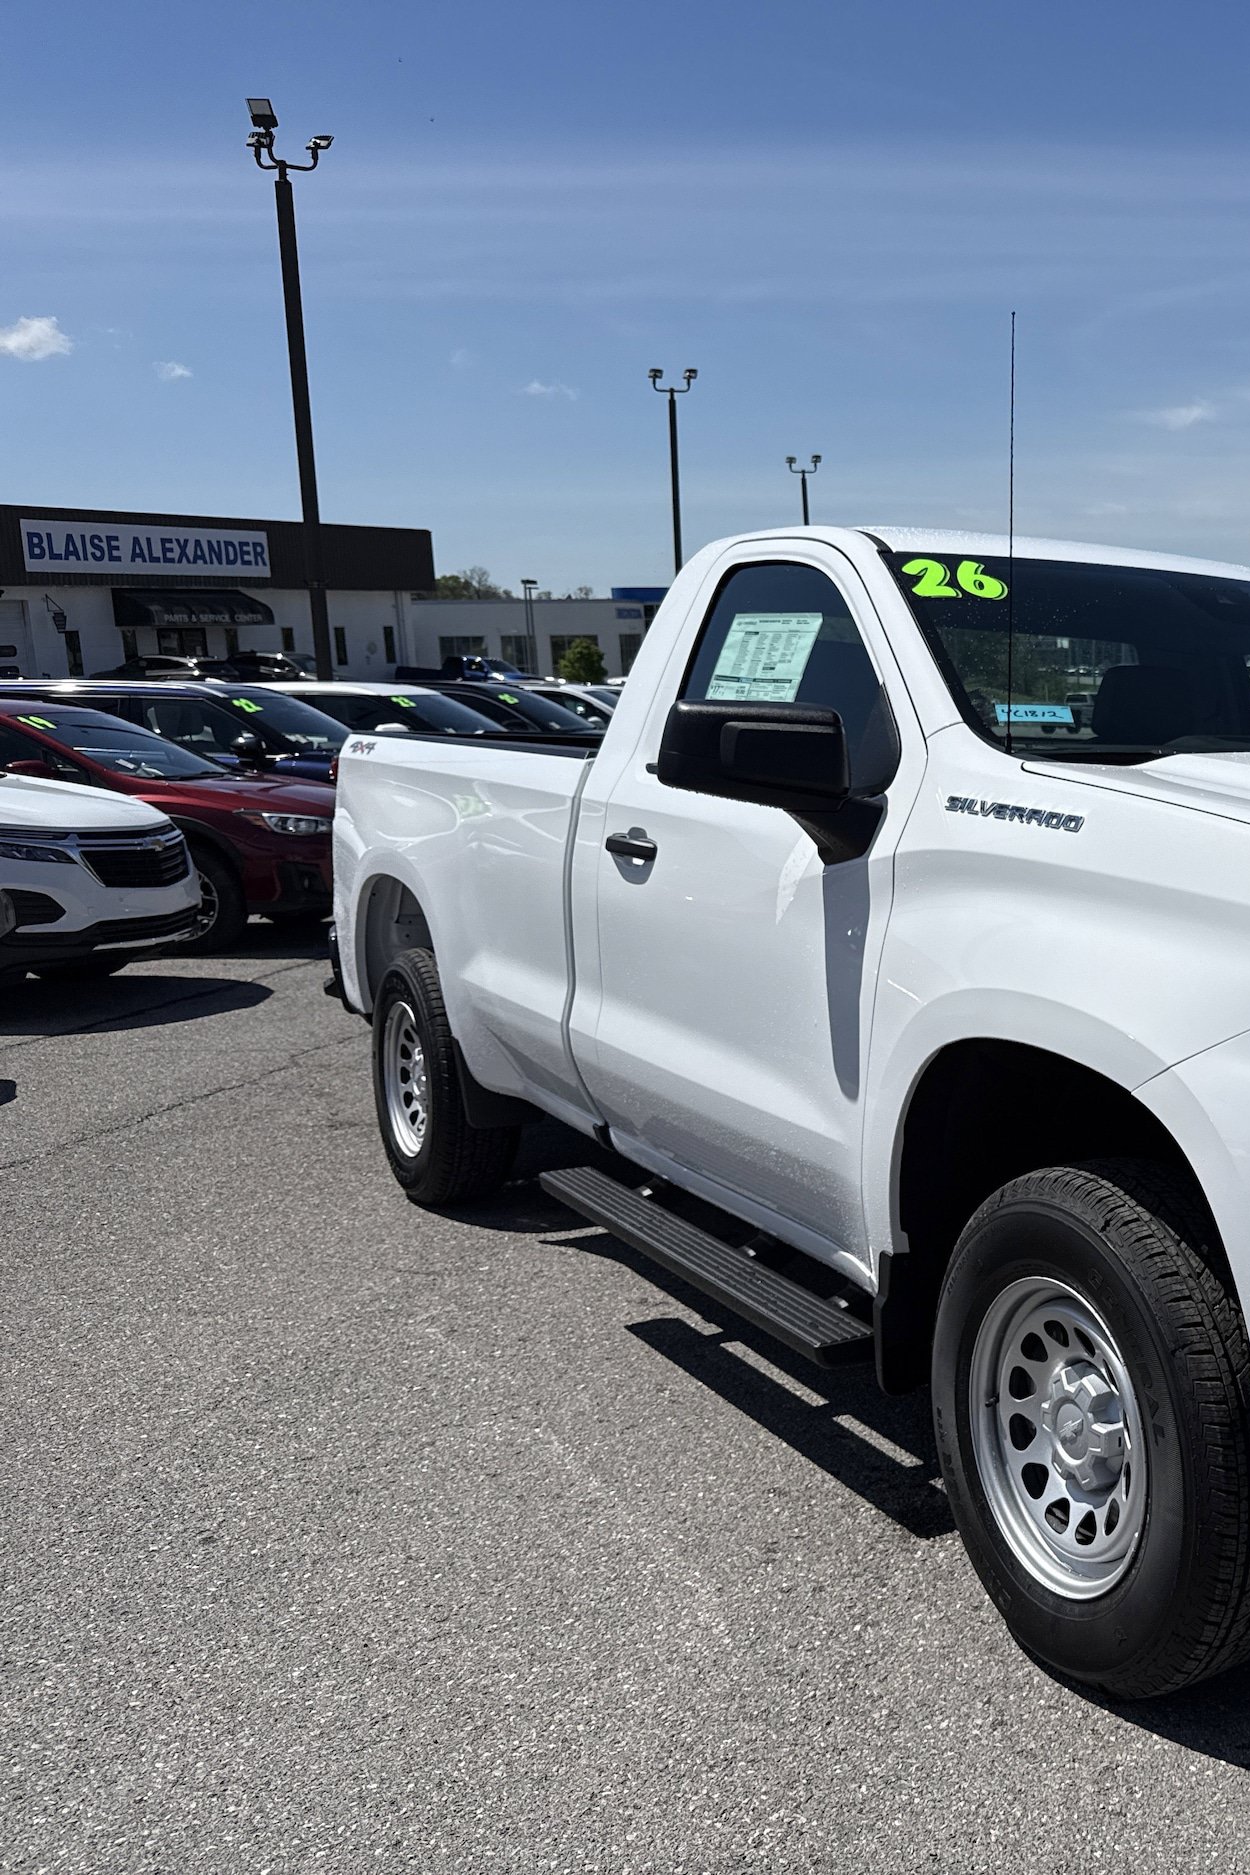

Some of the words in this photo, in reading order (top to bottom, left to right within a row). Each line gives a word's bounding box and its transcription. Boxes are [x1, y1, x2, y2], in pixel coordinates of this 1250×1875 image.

[26, 531, 122, 562] BLAISE
[130, 536, 268, 567] ALEXANDER
[901, 558, 1008, 600] 26
[164, 614, 189, 622] PARTS
[234, 614, 263, 622] CENTER
[945, 796, 1085, 833] SILVERADO
